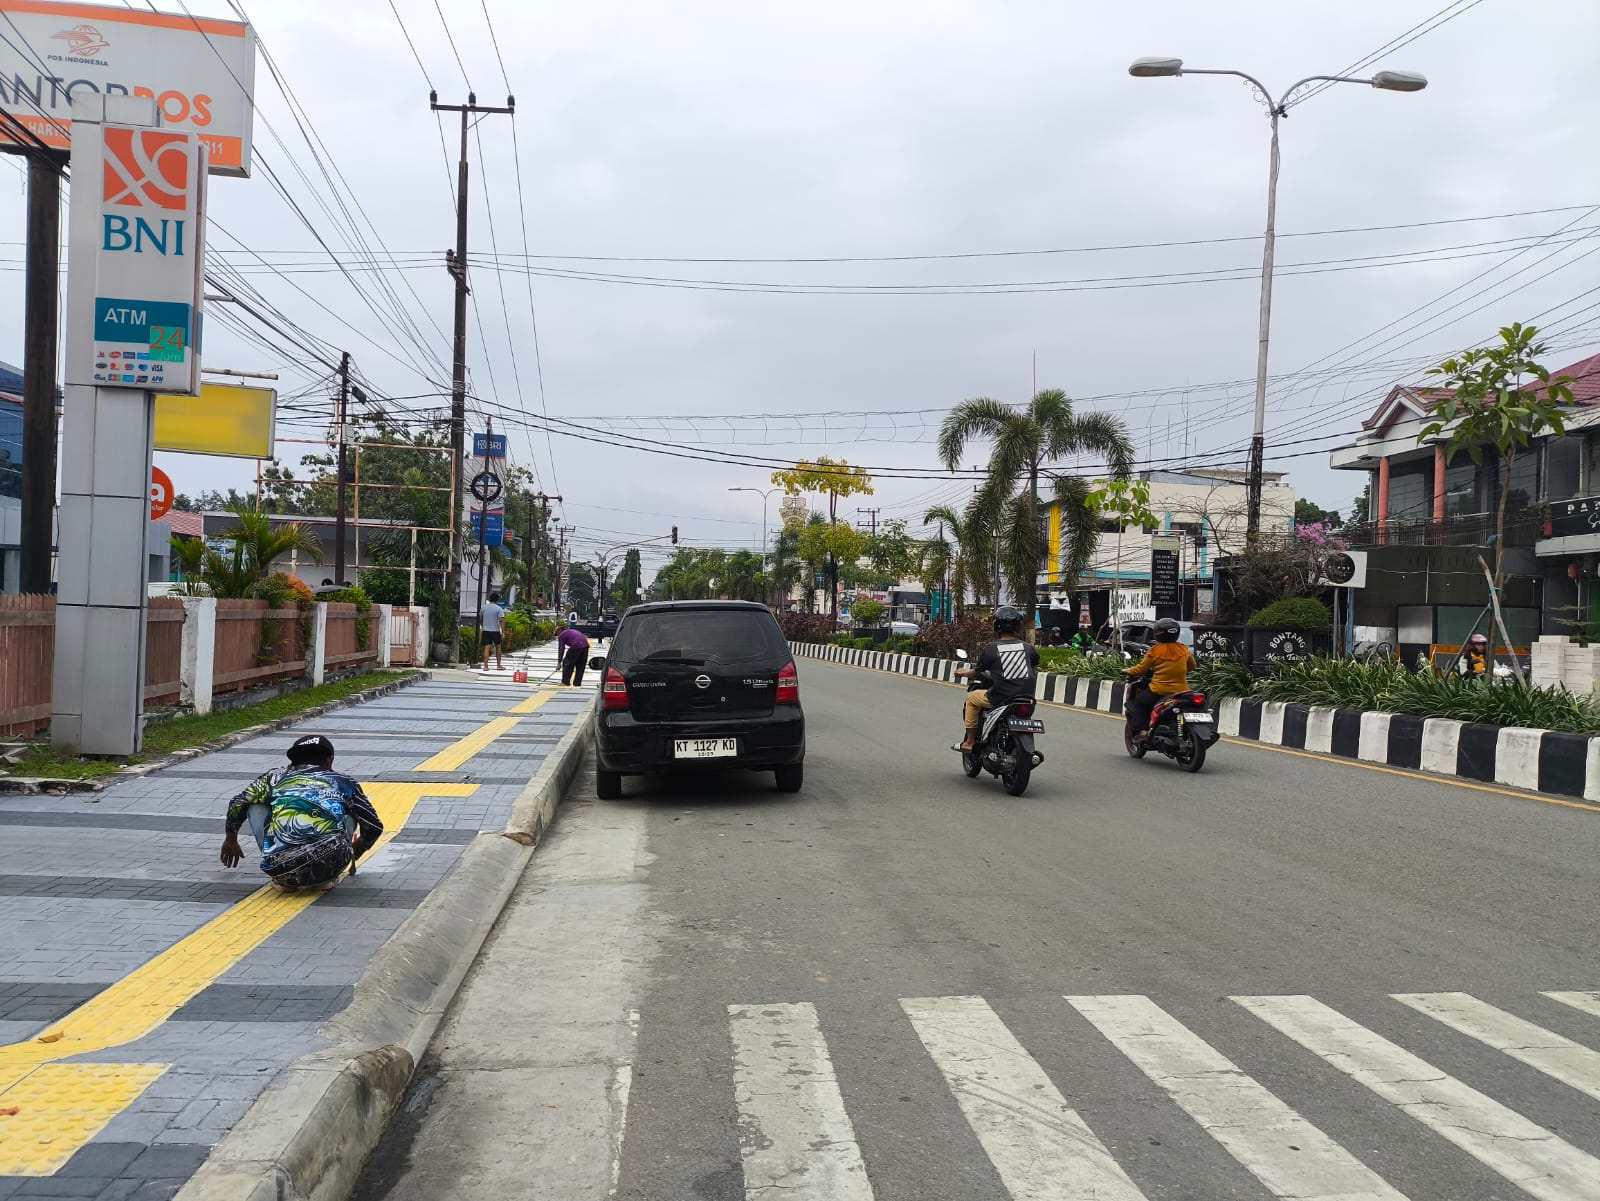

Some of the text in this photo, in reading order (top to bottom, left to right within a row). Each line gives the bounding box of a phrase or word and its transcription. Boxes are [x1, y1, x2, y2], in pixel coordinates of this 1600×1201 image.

[65, 56, 109, 66] INDONESIA
[101, 214, 185, 256] BNI
[104, 307, 147, 326] ATM
[150, 326, 185, 350] 24
[151, 364, 163, 372] VISA
[1269, 631, 1306, 649] BONTANG
[676, 739, 735, 752] KT 1127 KD
